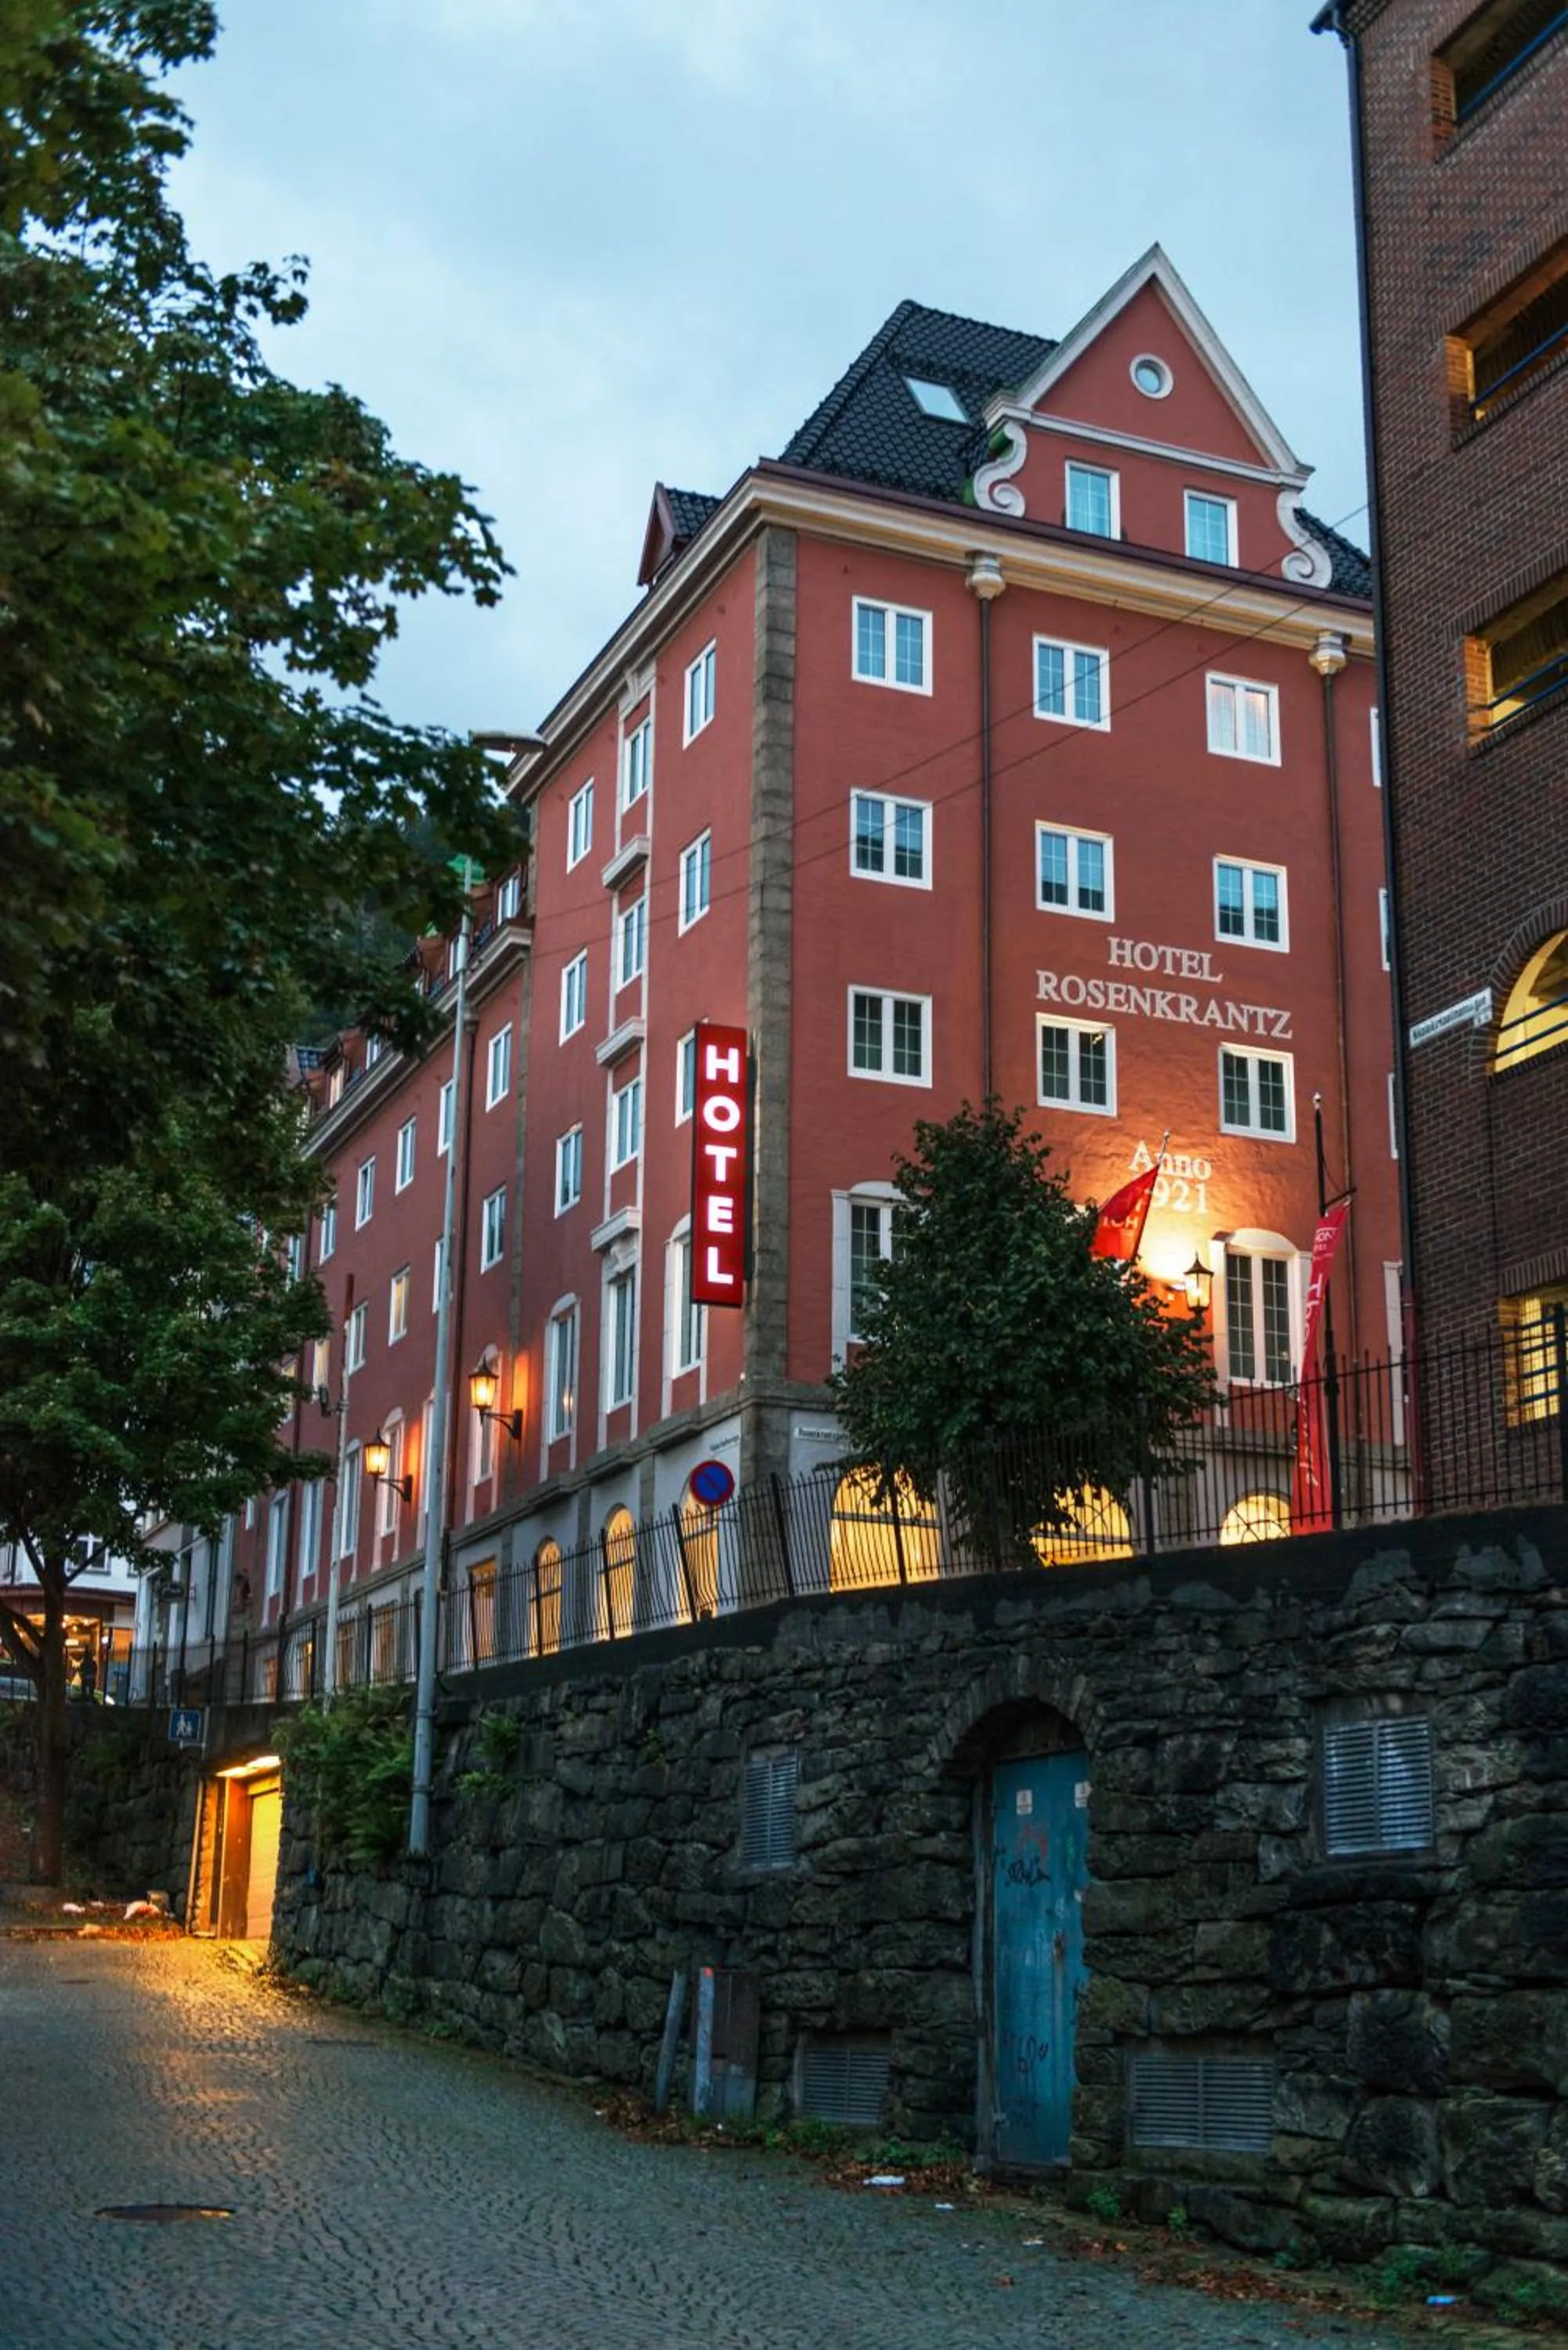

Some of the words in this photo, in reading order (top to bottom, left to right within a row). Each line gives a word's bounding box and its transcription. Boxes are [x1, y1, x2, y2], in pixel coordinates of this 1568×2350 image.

[1107, 937, 1223, 983] HOTEL
[1035, 970, 1293, 1039] ROSENKRANTZ
[703, 1044, 740, 1285] HOTEL
[1128, 1140, 1212, 1180] Anno
[1150, 1177, 1209, 1213] 921
